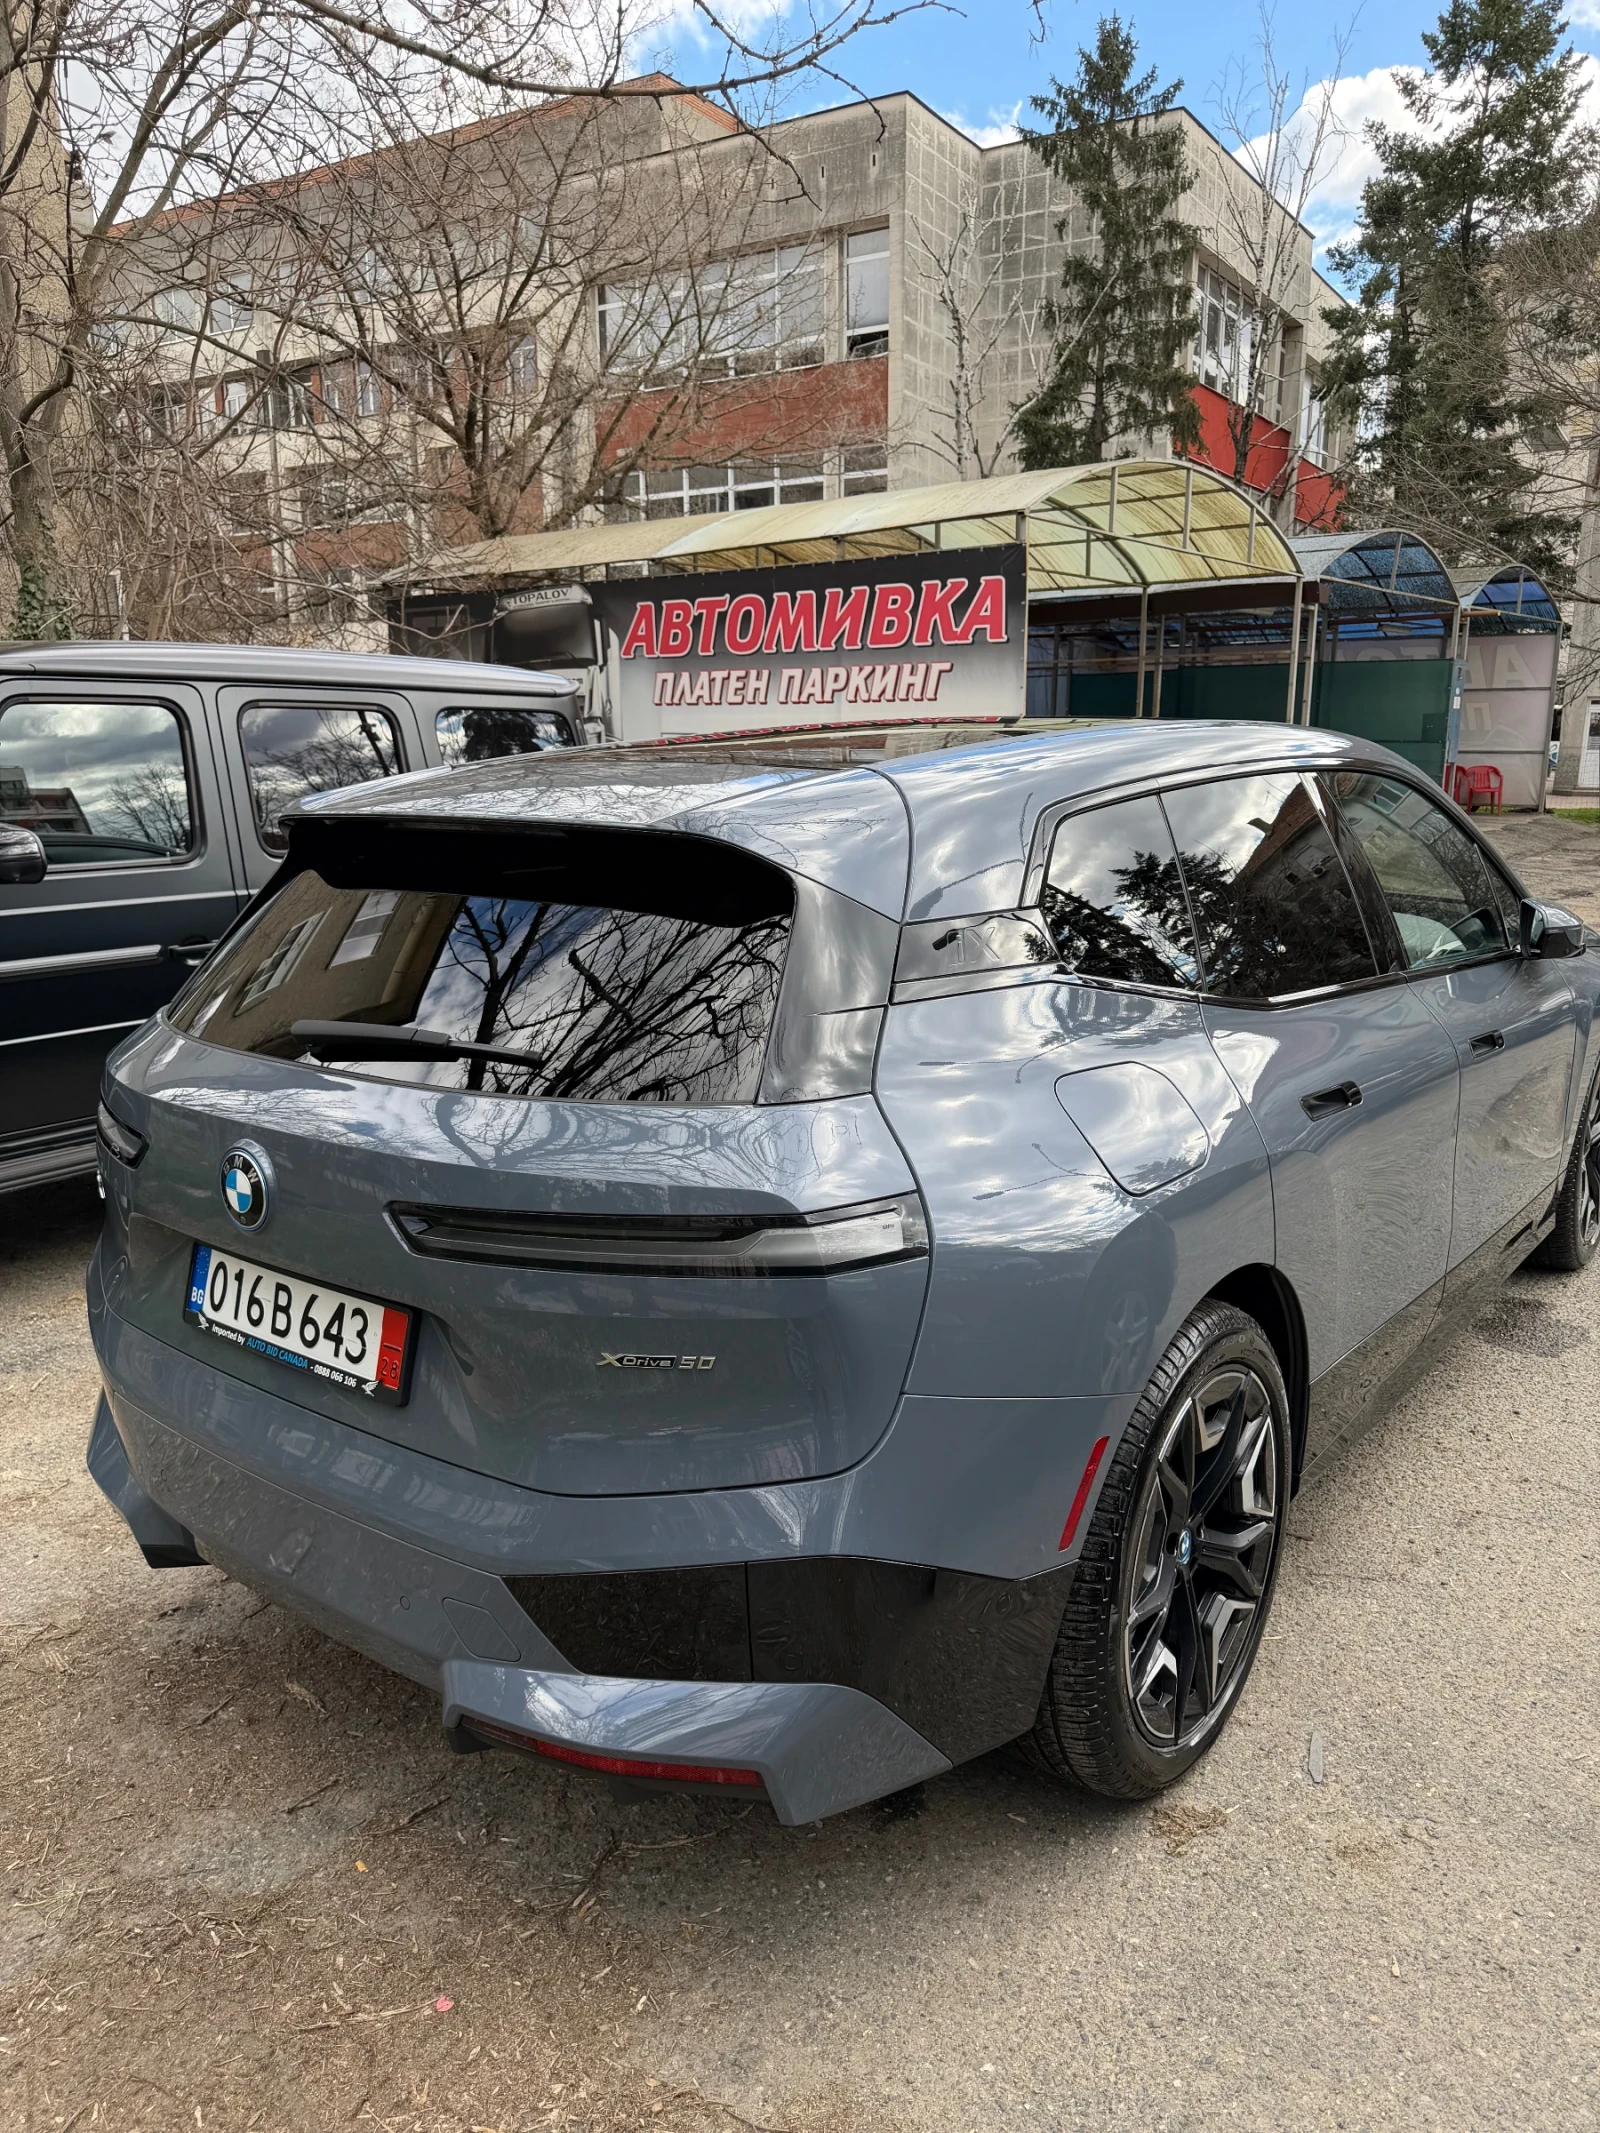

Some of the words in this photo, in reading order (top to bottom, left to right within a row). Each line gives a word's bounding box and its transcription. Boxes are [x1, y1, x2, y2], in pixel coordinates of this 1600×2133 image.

[512, 589, 569, 605] TOPALOV
[621, 575, 1008, 659] АВТОМИВКА
[653, 669, 771, 706] ПЛАТЕН
[777, 661, 953, 705] ПАРКИНГ
[223, 1155, 260, 1184] BMW
[191, 1286, 204, 1304] BG
[212, 1324, 237, 1340] Imported
[237, 1333, 246, 1345] by
[247, 1338, 265, 1352] AUTO
[266, 1345, 278, 1356] BID
[279, 1350, 308, 1369] CANADA
[314, 1364, 331, 1378] 0888
[330, 1371, 343, 1382] 066
[344, 1376, 357, 1387] 106
[381, 1357, 398, 1379] 28
[678, 1356, 716, 1370] 50
